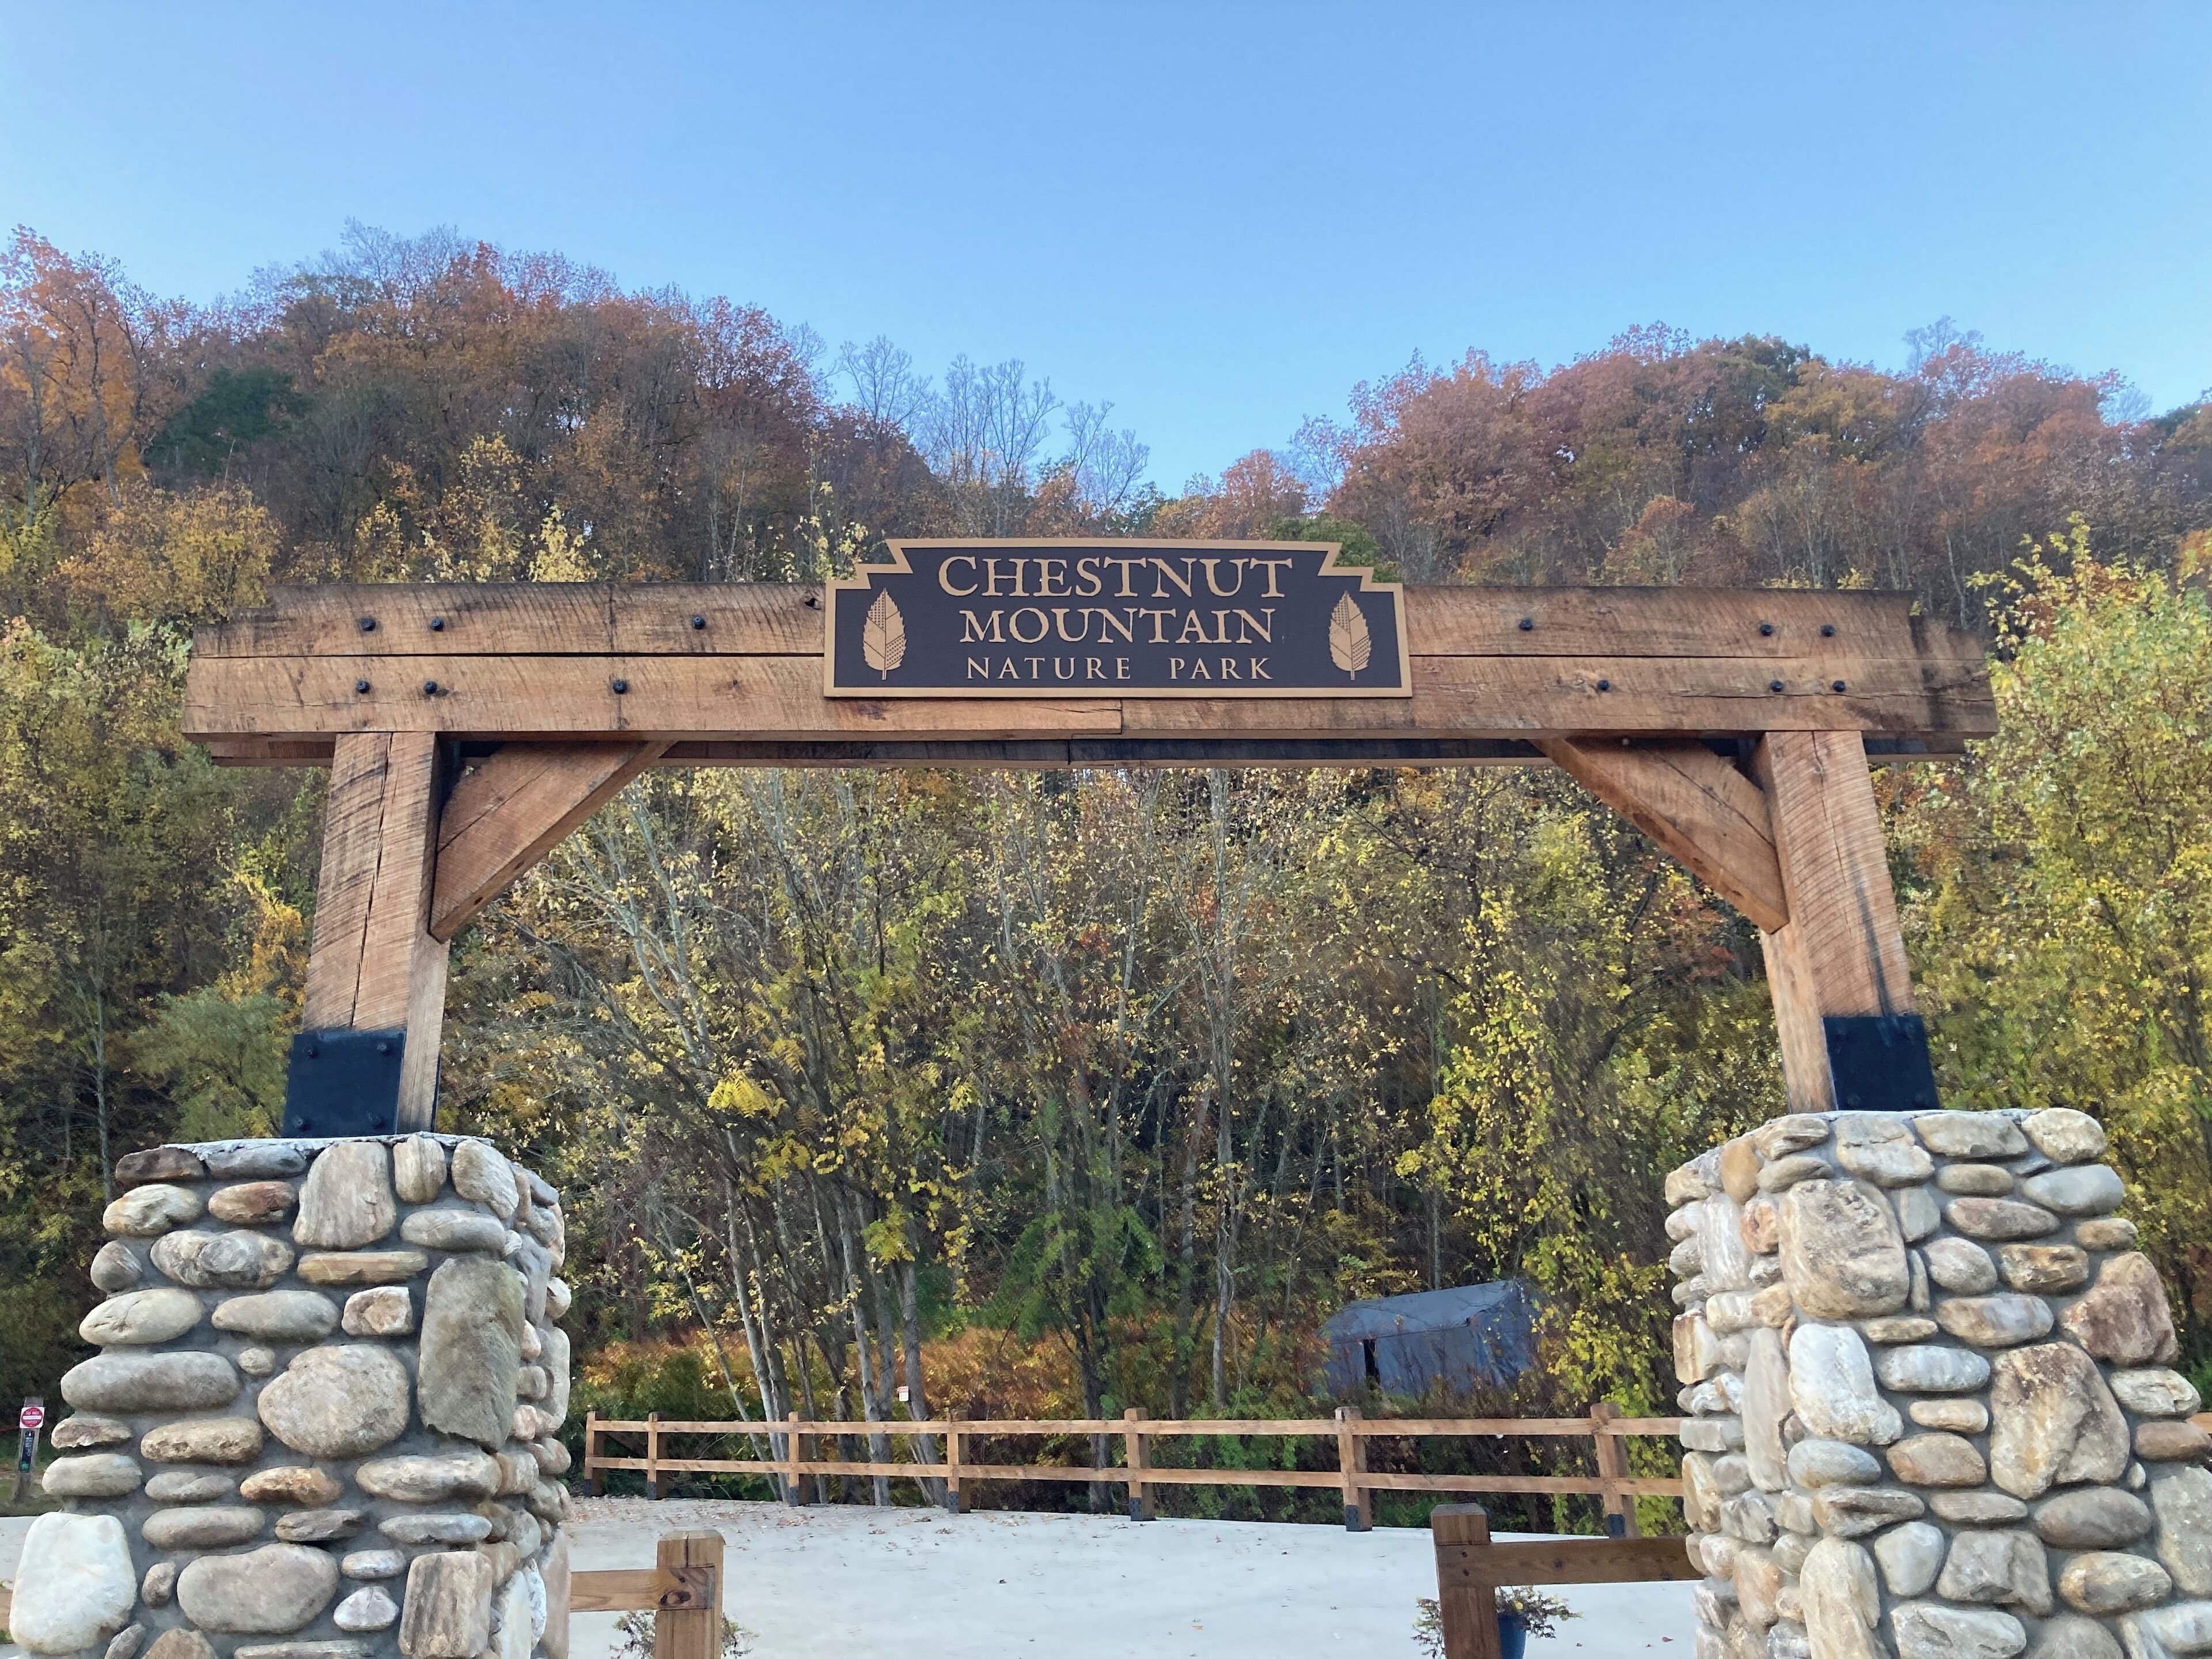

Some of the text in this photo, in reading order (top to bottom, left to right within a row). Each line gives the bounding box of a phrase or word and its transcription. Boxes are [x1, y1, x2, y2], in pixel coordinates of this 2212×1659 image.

[938, 556, 1293, 597] CHESTNUT
[959, 608, 1275, 643] MOUNTAIN
[966, 658, 1274, 681] NATURE PARK
